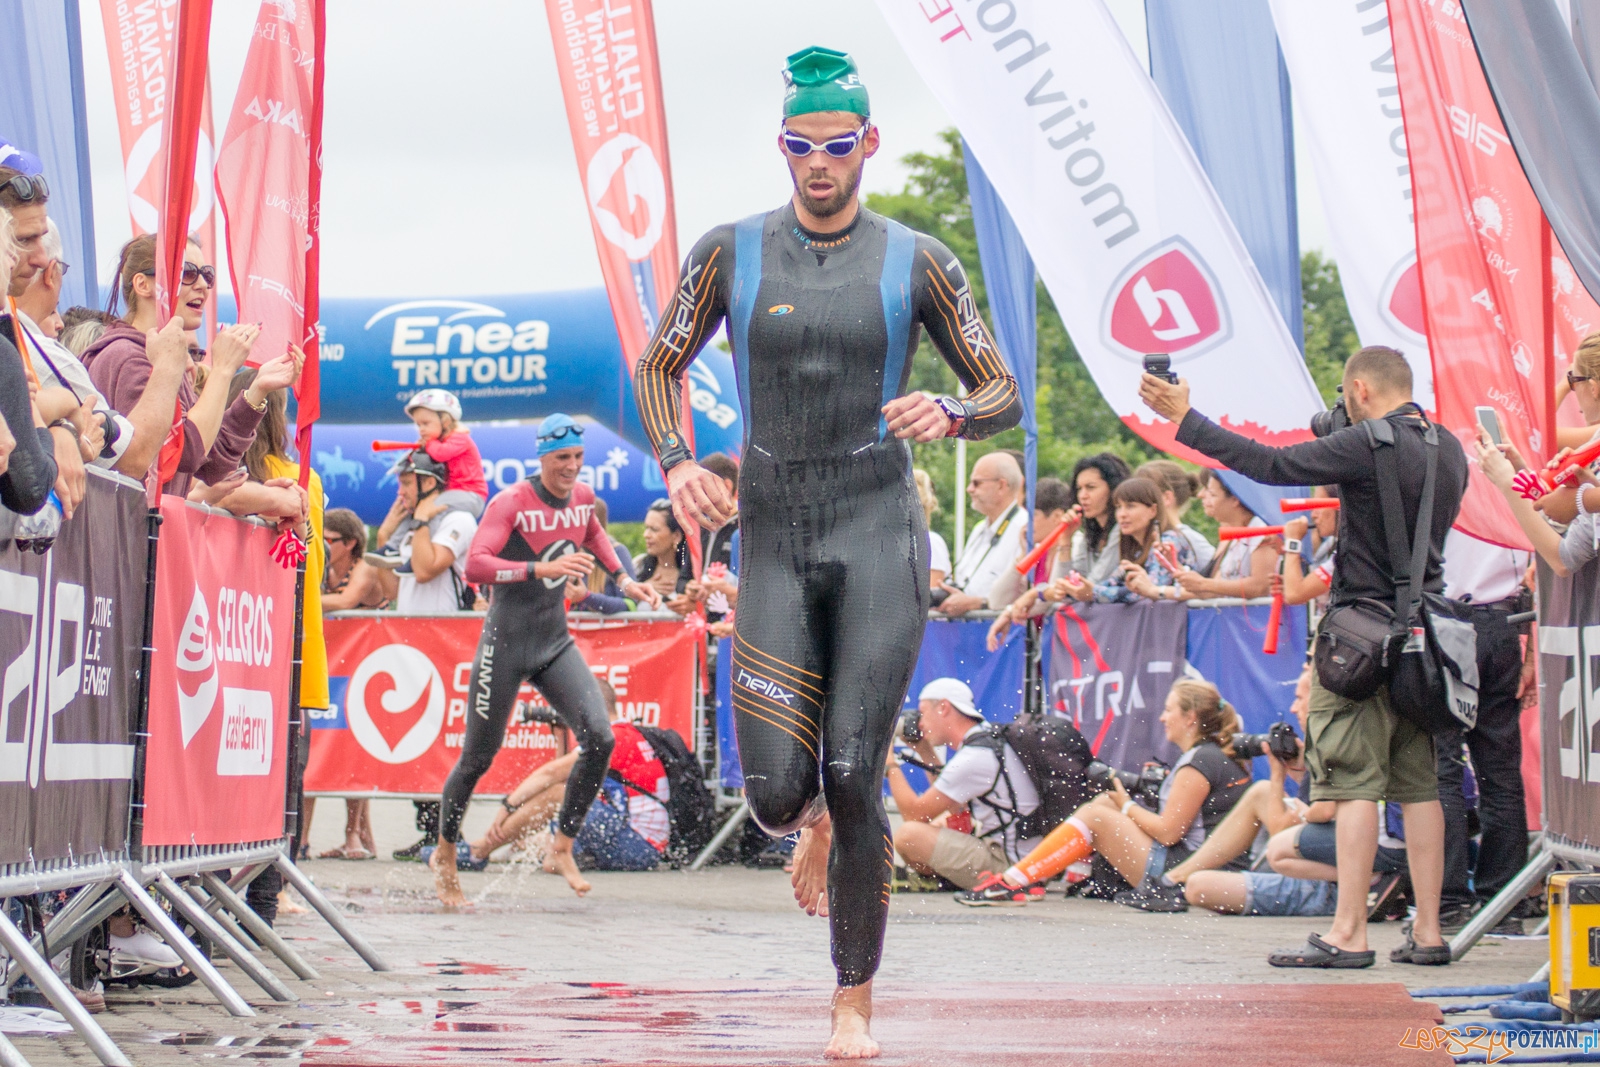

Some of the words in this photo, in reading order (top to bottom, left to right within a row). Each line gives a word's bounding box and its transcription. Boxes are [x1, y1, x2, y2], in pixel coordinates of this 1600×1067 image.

[793, 227, 851, 248] blueseventy
[661, 255, 702, 353] helix
[946, 257, 992, 358] helix
[390, 316, 550, 356] Enea
[392, 354, 548, 387] TRITOUR
[216, 586, 274, 668] SELGROS
[475, 643, 495, 720] ATLANTE
[737, 668, 795, 706] helix
